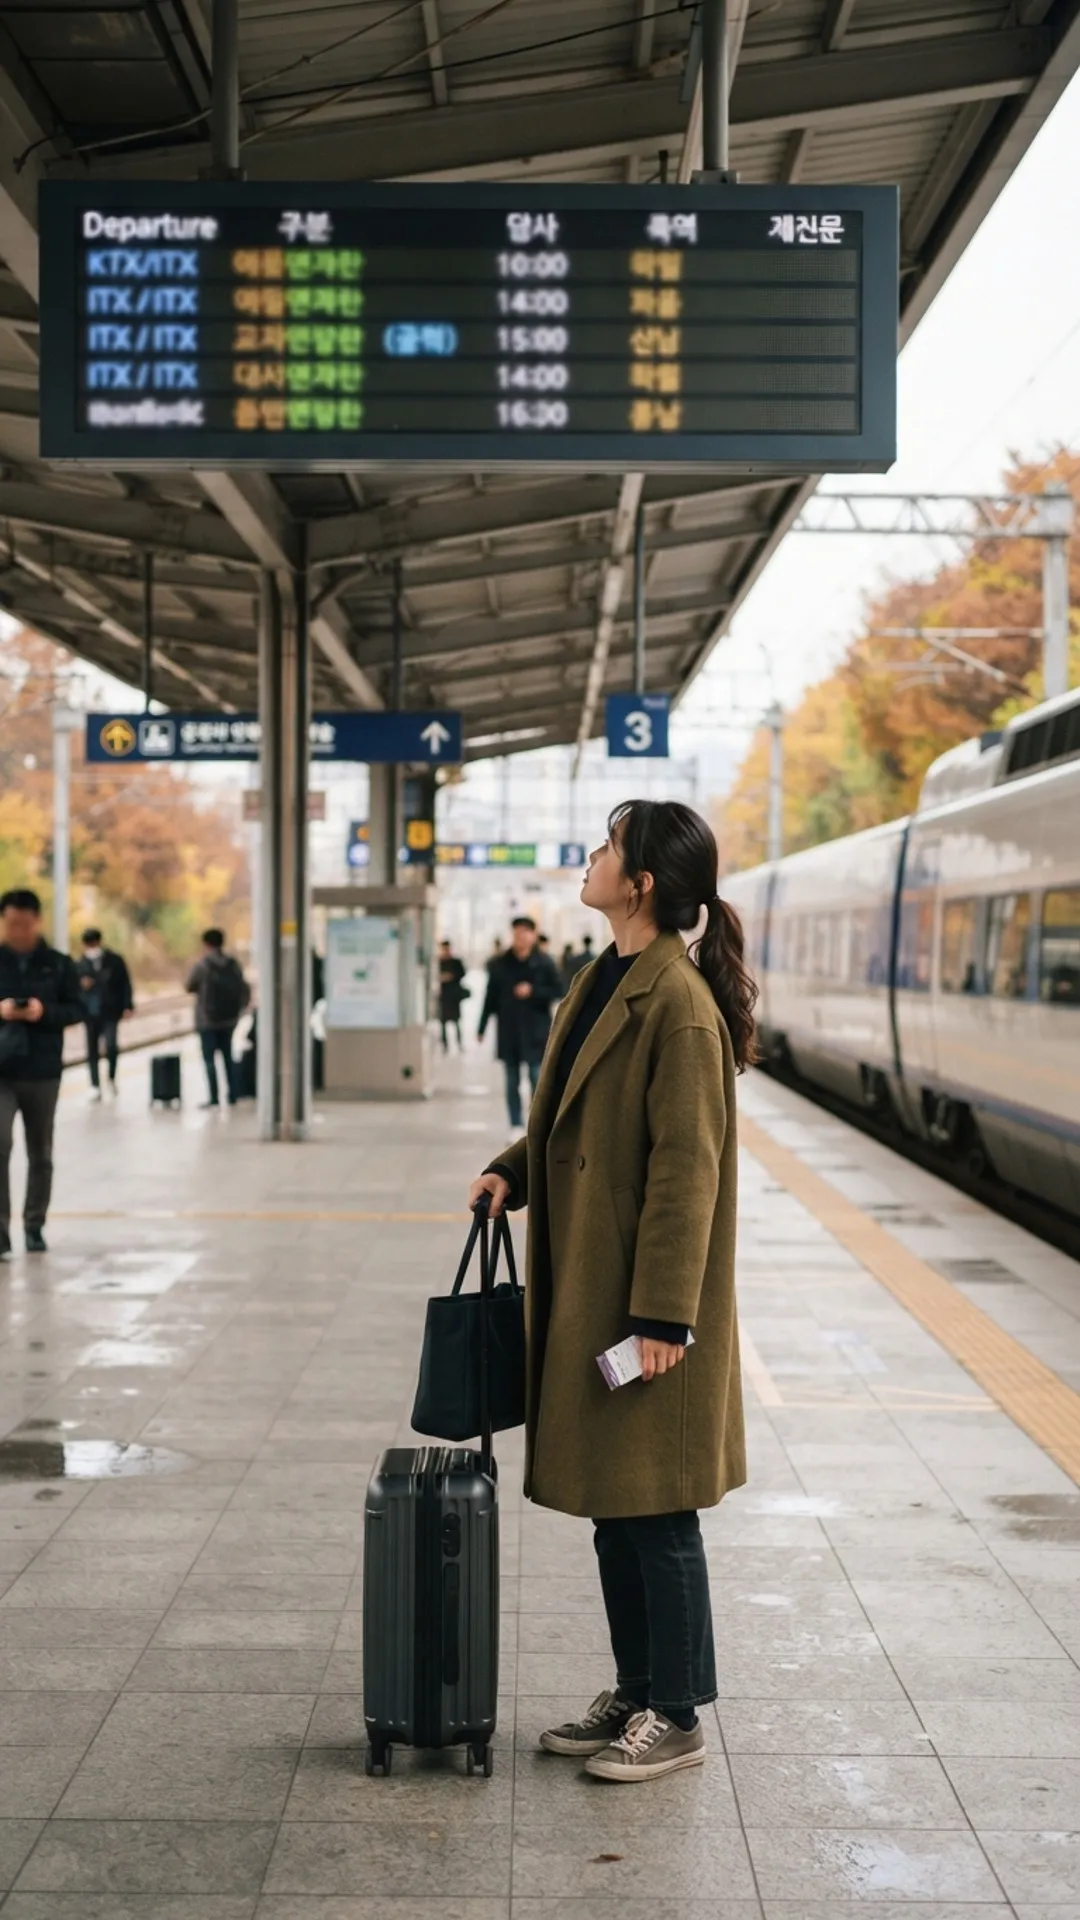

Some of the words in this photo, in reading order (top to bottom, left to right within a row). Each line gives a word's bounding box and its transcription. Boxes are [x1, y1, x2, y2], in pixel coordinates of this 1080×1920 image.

[83, 211, 218, 242] Departure
[498, 252, 569, 278] 10:00
[624, 710, 653, 752] 3
